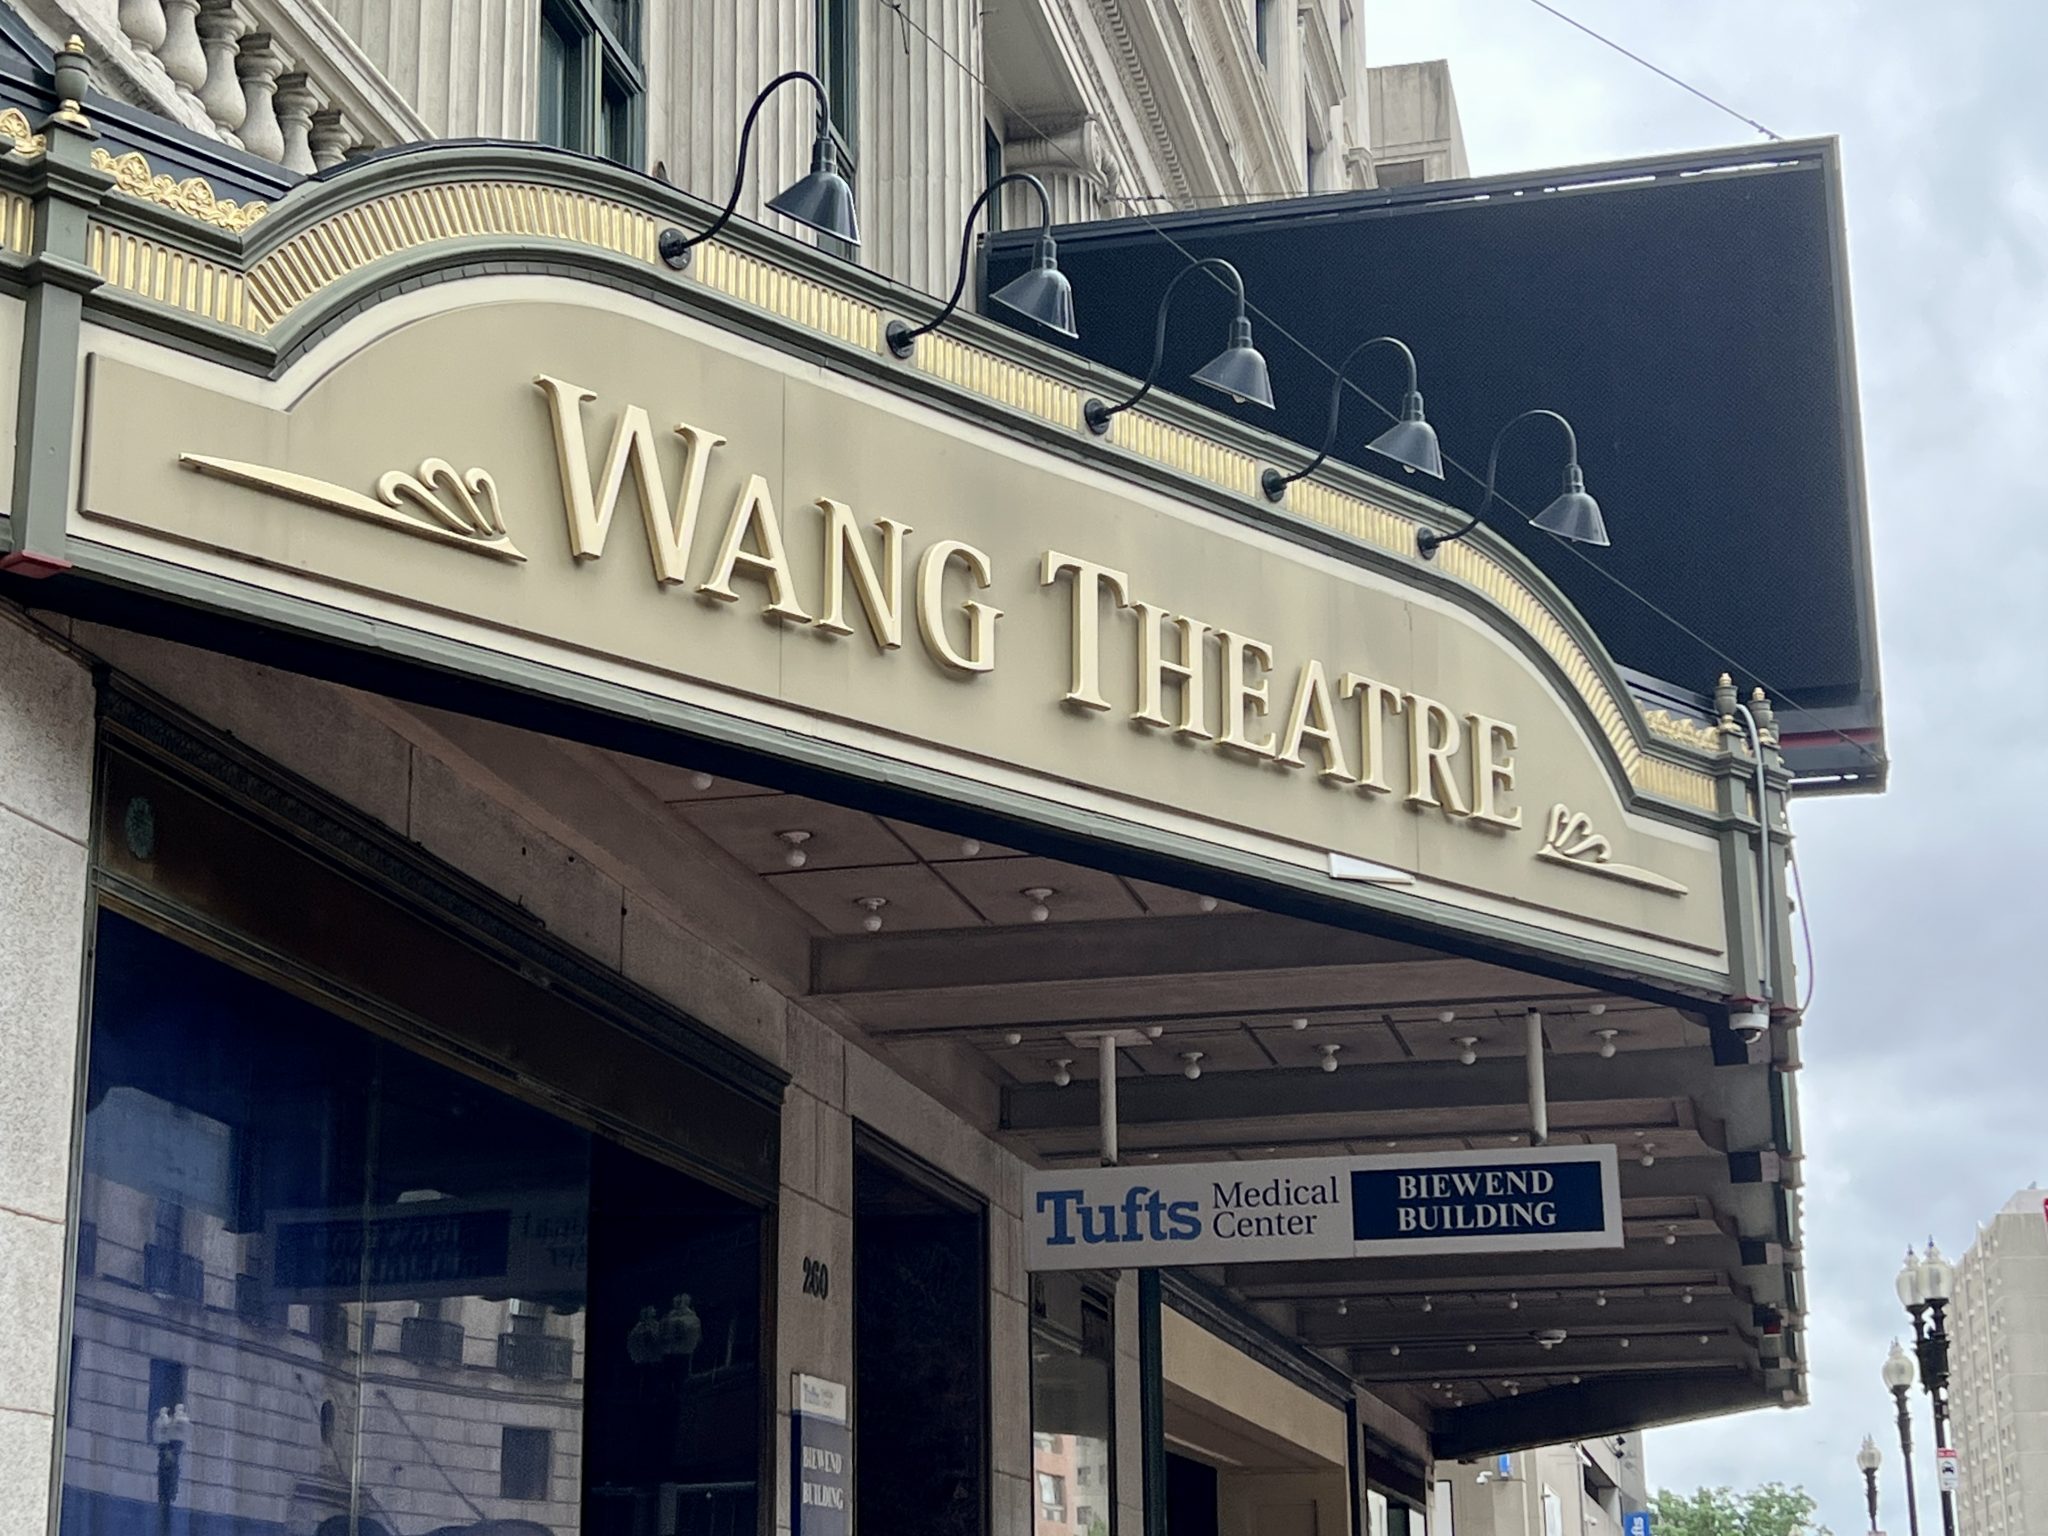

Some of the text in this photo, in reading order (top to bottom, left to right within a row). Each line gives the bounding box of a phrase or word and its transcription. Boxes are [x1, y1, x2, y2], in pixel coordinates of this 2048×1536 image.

[533, 374, 1522, 830] WANG THEATRE
[1212, 1176, 1340, 1209] Medical
[1398, 1170, 1554, 1199] BIEWEND
[1036, 1186, 1202, 1245] Tufts
[1212, 1211, 1318, 1238] Center
[1398, 1202, 1557, 1231] BUILDING
[803, 1257, 828, 1300] 260
[803, 1482, 844, 1510] BUILDING
